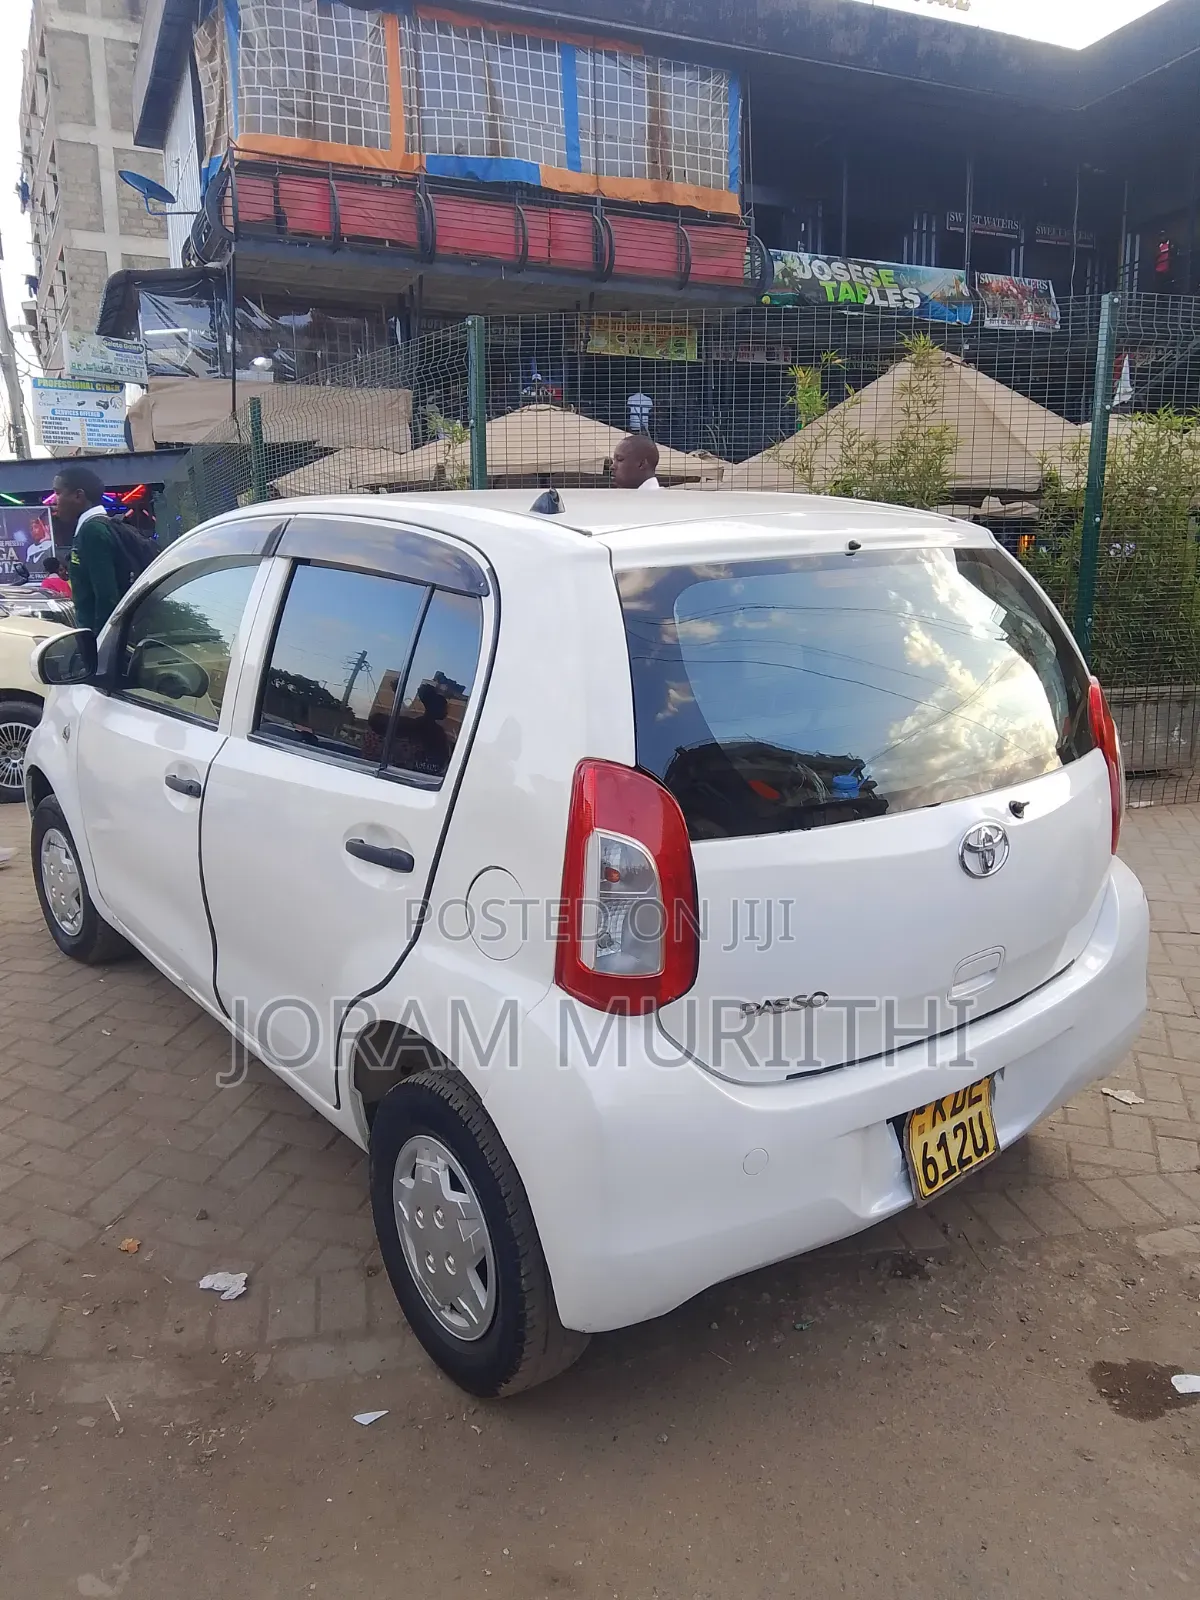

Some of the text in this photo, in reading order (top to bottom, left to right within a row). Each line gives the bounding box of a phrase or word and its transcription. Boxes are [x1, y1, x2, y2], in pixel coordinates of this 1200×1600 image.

[949, 211, 983, 225] SWET
[983, 215, 1019, 231] WATERS
[793, 253, 898, 289] JOSESE
[819, 281, 921, 309] TABLES
[37, 378, 121, 392] PROFESSIONAL CYBER
[54, 408, 79, 417] SERVICES
[740, 991, 829, 1019] PASSO
[921, 1110, 990, 1189] 612U
